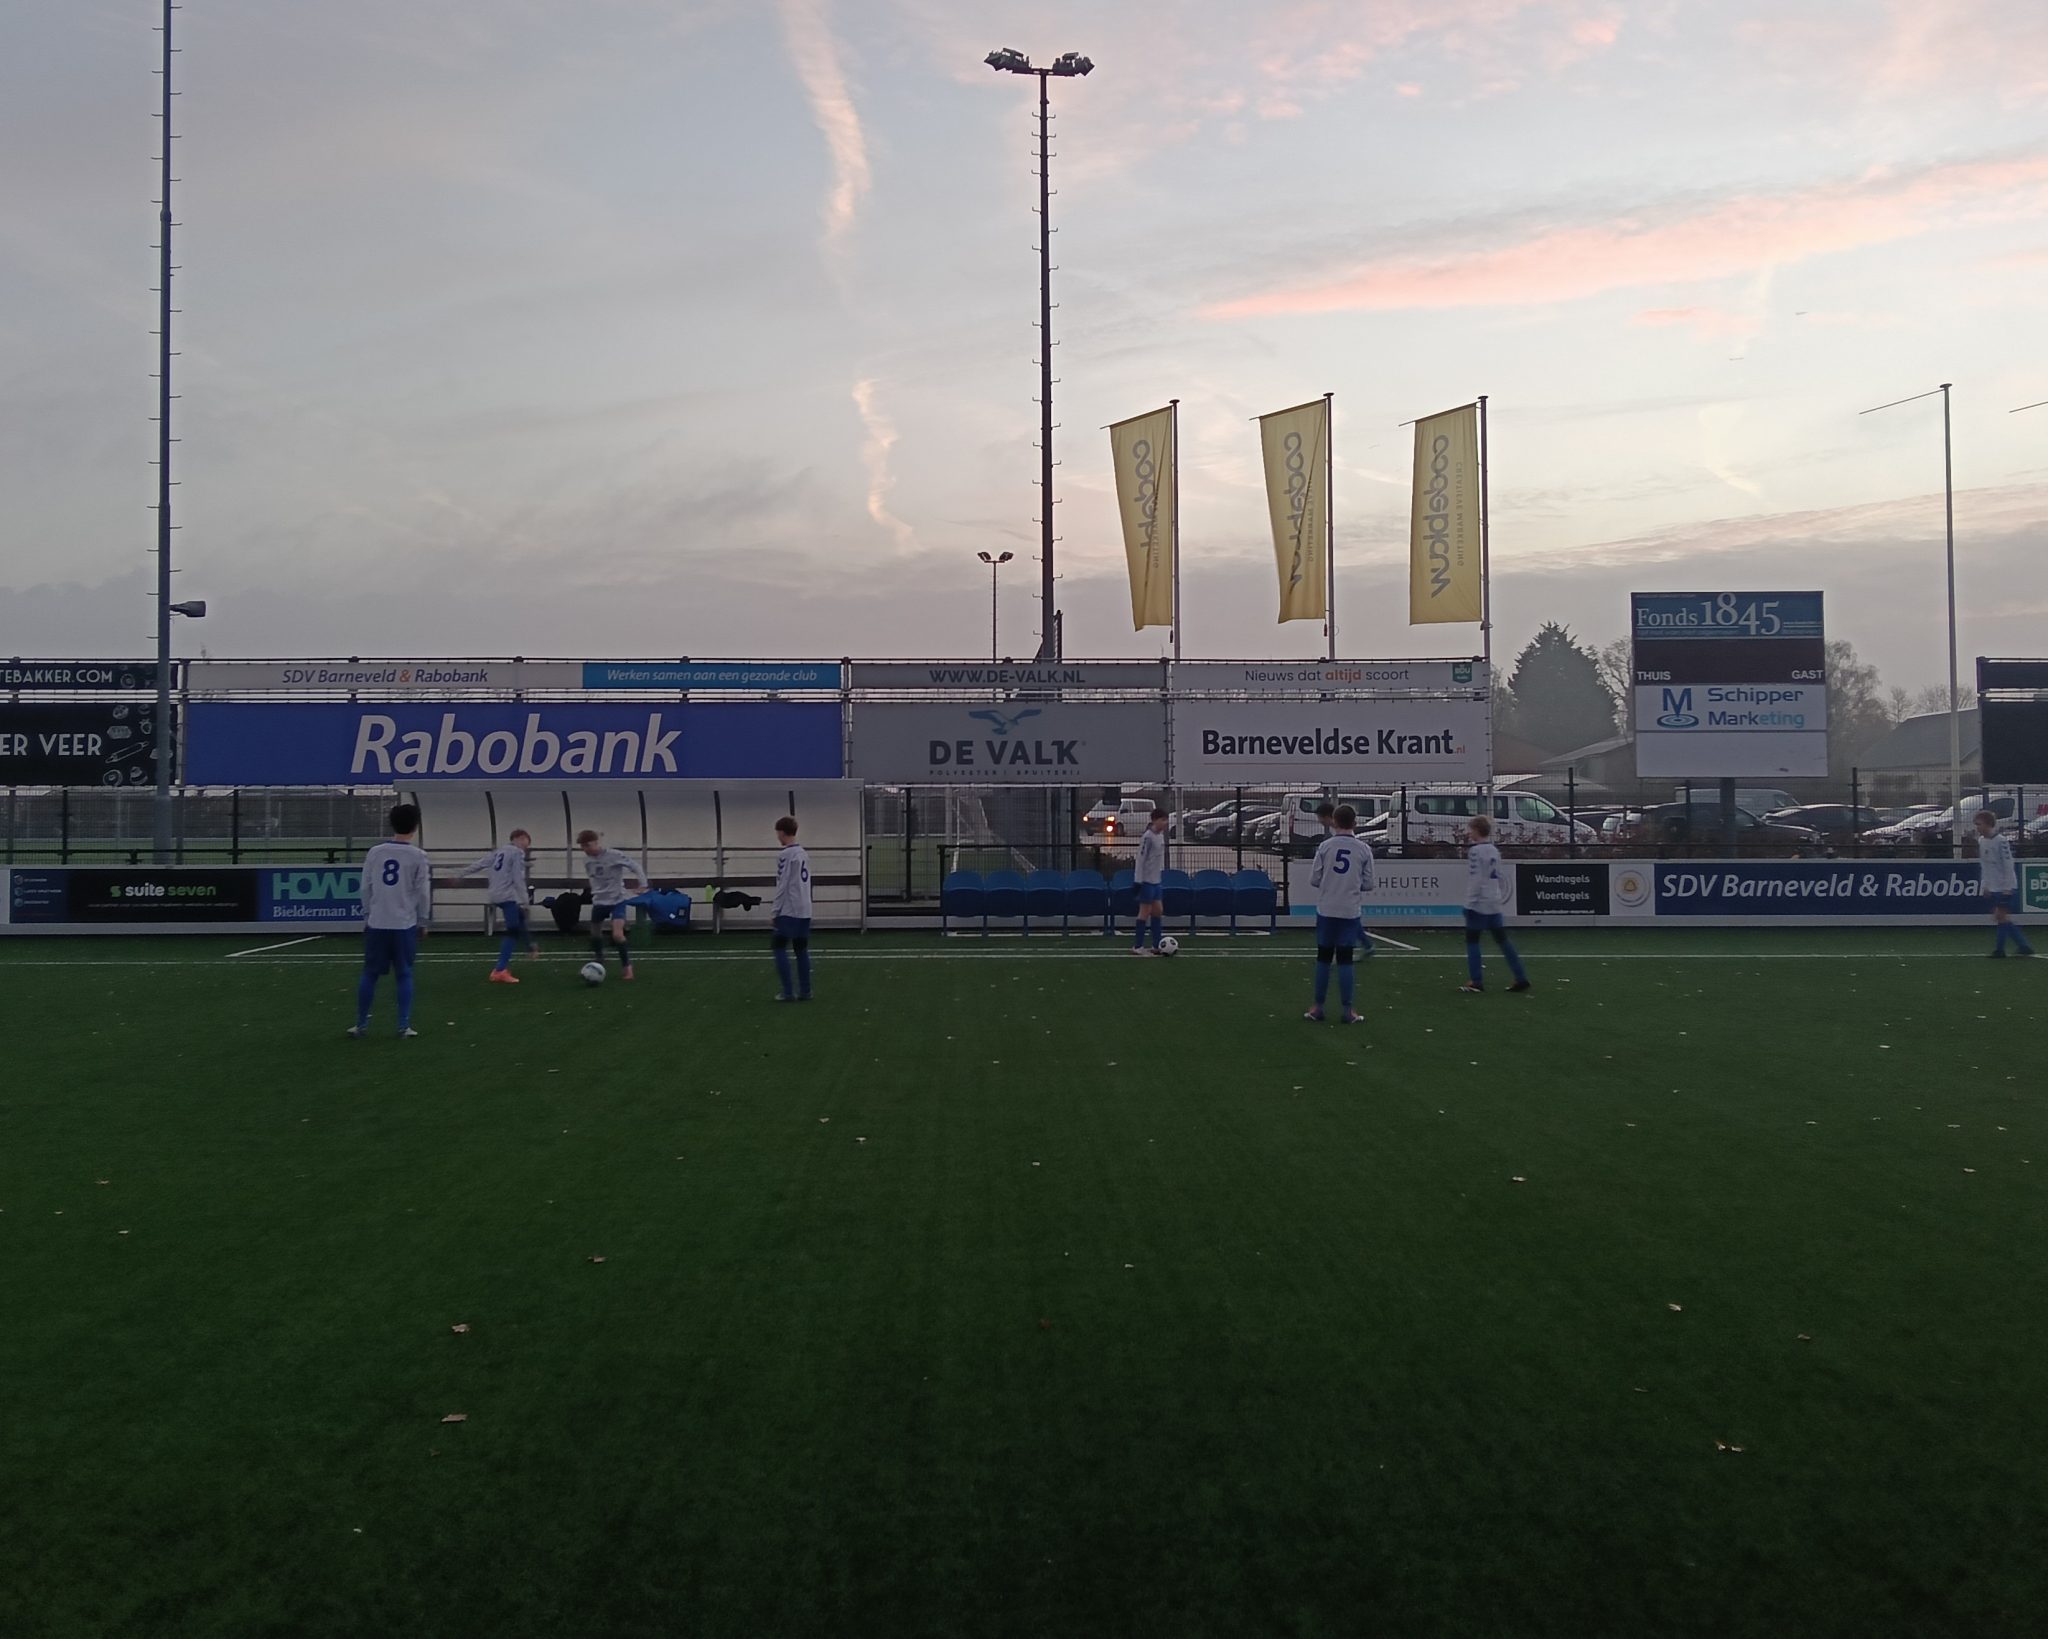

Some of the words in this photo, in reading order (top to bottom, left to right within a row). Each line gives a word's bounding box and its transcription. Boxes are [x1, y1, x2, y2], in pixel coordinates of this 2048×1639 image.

[1636, 608, 1698, 626] Fonds
[1702, 592, 1781, 635] 1845
[282, 669, 316, 683] SDV
[318, 669, 396, 683] Barneveld
[400, 669, 411, 683] &
[415, 668, 488, 683] Rabobank
[607, 669, 650, 681] Werken
[652, 672, 691, 681] samen
[693, 672, 716, 681] aan
[718, 672, 740, 681] een
[741, 669, 791, 684] gezonde
[793, 669, 817, 681] club
[929, 670, 1086, 683] WWW.DE-VALK.NL
[1245, 669, 1294, 682] Nieuws
[1297, 669, 1321, 681] dat
[1325, 669, 1362, 684] altijd
[1366, 669, 1409, 681] scoort
[1637, 671, 1671, 681] THUIS
[1791, 669, 1824, 680] GAST
[1707, 687, 1804, 705] Schipper
[1708, 711, 1805, 728] Marketing
[38, 733, 102, 756] VEER
[351, 713, 682, 775] Rabobank
[1202, 728, 1370, 755] Barneveldse
[929, 740, 974, 765] DE
[986, 740, 1079, 765] VALK
[1333, 849, 1351, 874] 5
[383, 860, 399, 886] 8
[1535, 874, 1590, 885] Wandtegels
[125, 882, 165, 897] suite
[168, 885, 217, 897] seven
[1374, 876, 1440, 888] HEUTER
[1662, 874, 1718, 897] SDV
[1722, 873, 1853, 897] Barneveld
[1859, 873, 1878, 897] &
[1536, 891, 1590, 901] Vloertegels
[273, 905, 346, 918] Bielderman
